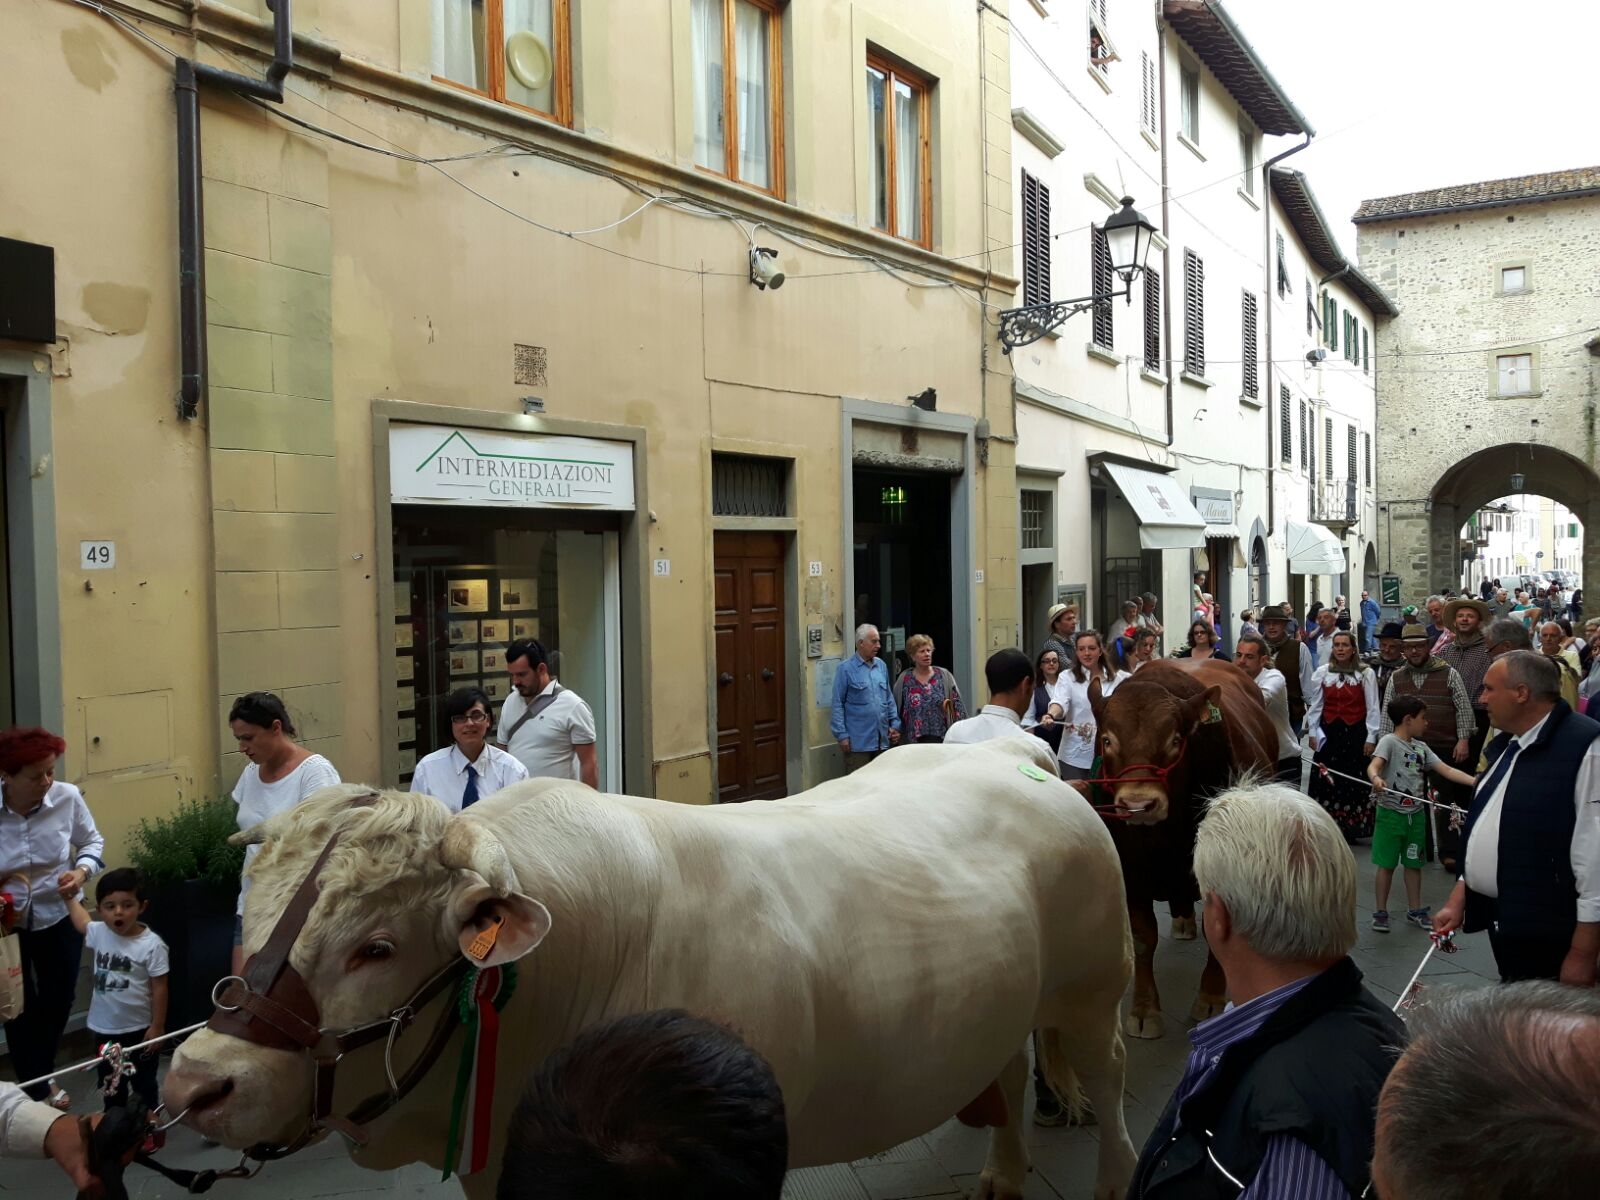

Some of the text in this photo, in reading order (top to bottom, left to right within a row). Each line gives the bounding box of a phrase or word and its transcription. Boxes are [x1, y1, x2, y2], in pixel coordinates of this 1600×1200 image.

[437, 456, 612, 484] INTERMEDIAZIONI
[489, 479, 572, 498] GENERALI
[86, 546, 110, 563] 49
[657, 561, 668, 574] 51
[811, 564, 820, 574] 53
